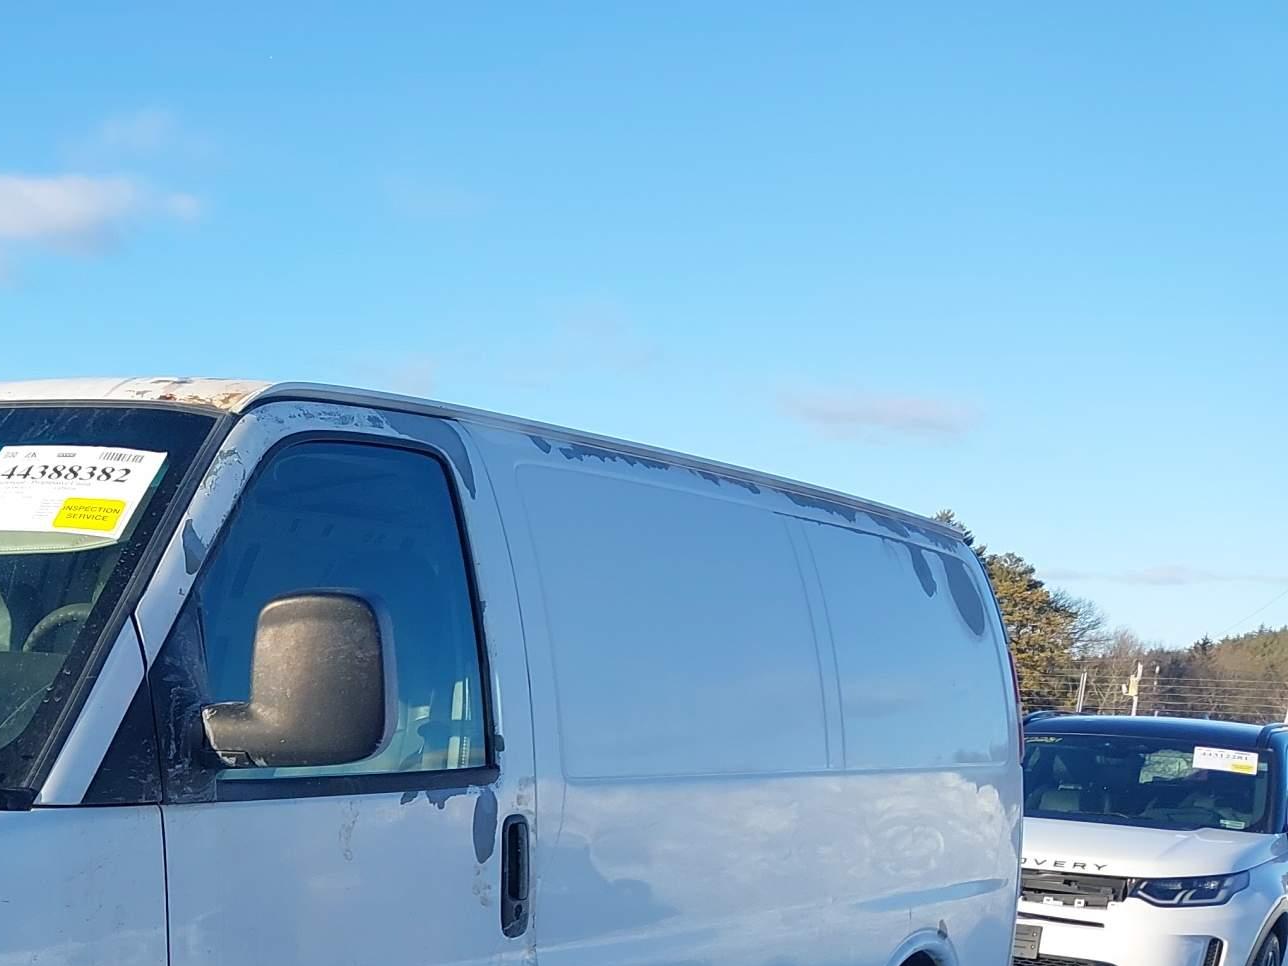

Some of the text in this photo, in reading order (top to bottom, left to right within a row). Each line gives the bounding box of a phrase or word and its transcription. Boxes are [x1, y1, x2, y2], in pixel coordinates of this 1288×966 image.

[1, 464, 132, 483] 44388382
[62, 504, 121, 515] INSPECTION
[66, 512, 110, 522] SERVICE
